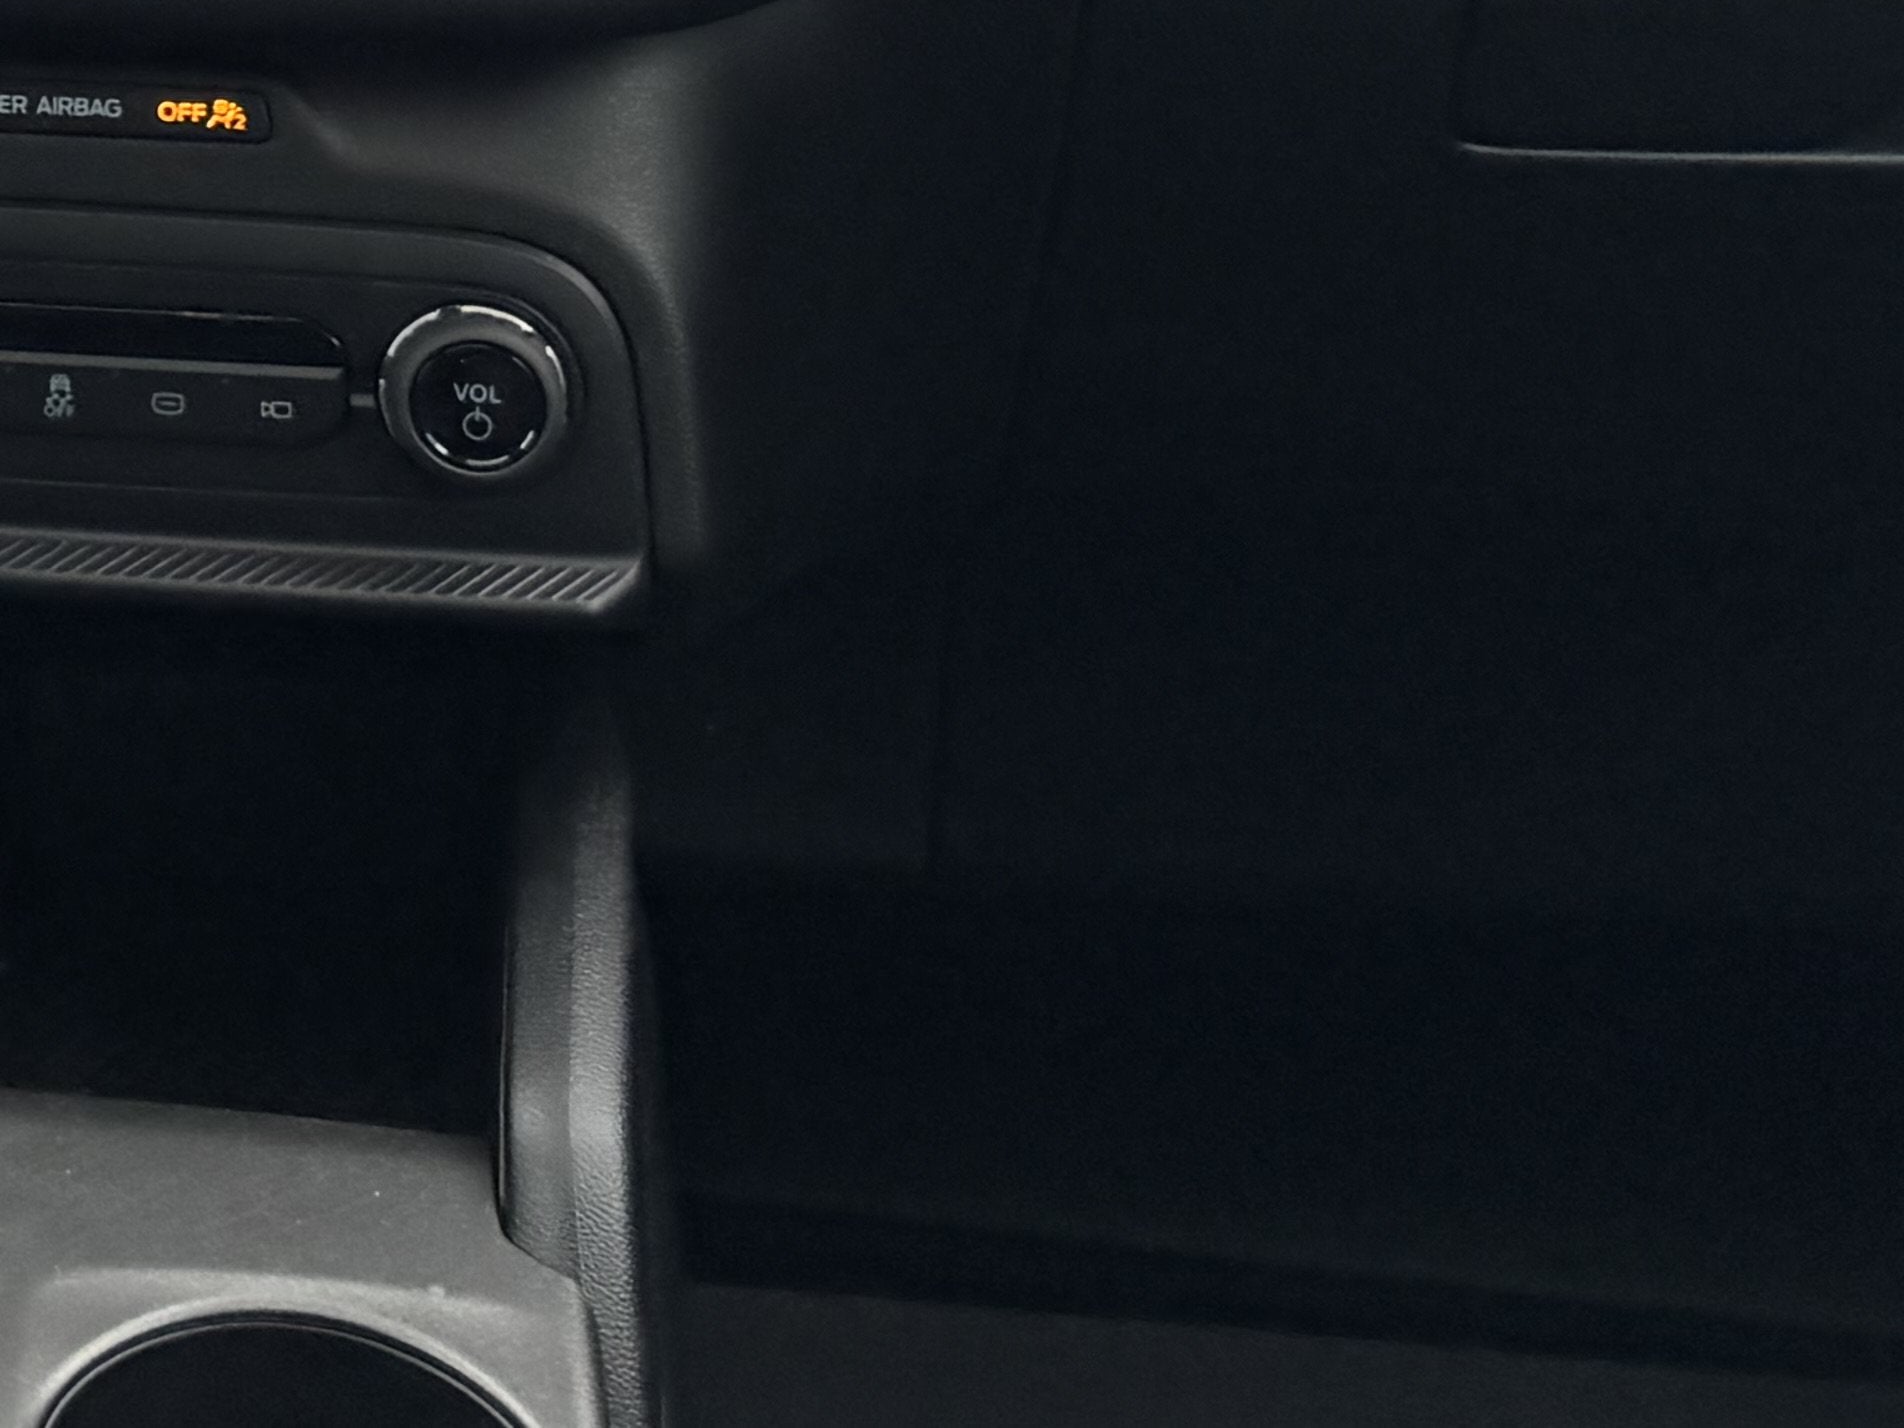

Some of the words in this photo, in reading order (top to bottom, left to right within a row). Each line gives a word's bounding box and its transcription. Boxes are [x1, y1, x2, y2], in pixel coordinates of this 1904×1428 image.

[36, 95, 123, 119] AIRBAG
[157, 101, 208, 122] OFF
[453, 382, 502, 405] VOL
